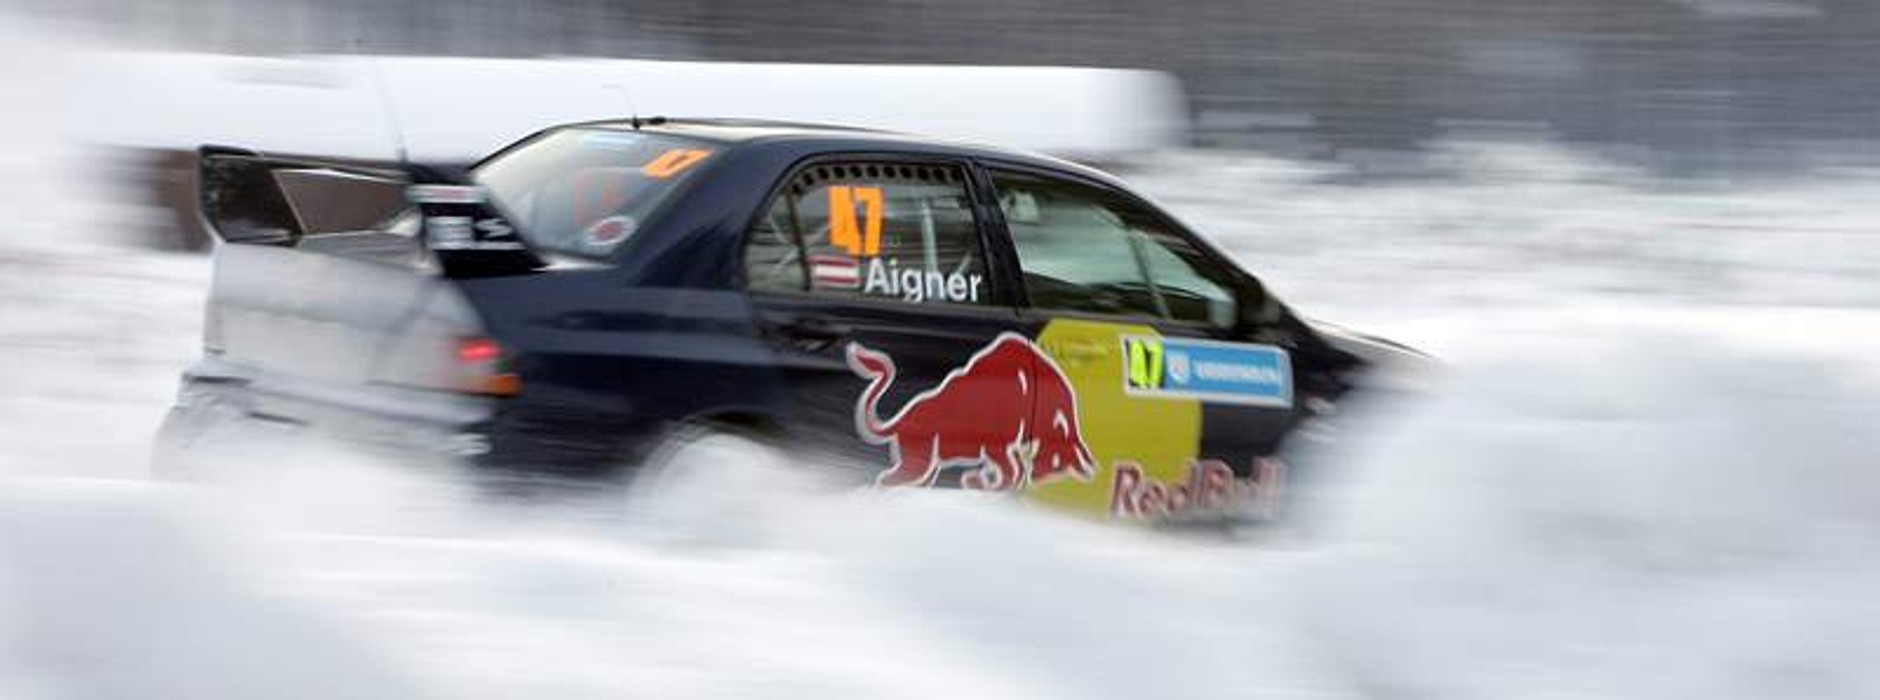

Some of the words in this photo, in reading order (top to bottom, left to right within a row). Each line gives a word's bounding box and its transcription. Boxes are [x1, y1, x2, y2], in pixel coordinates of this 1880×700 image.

[829, 185, 885, 257] 47
[864, 257, 982, 302] Aigner
[1129, 338, 1165, 387] 47
[1110, 457, 1198, 520] Red
